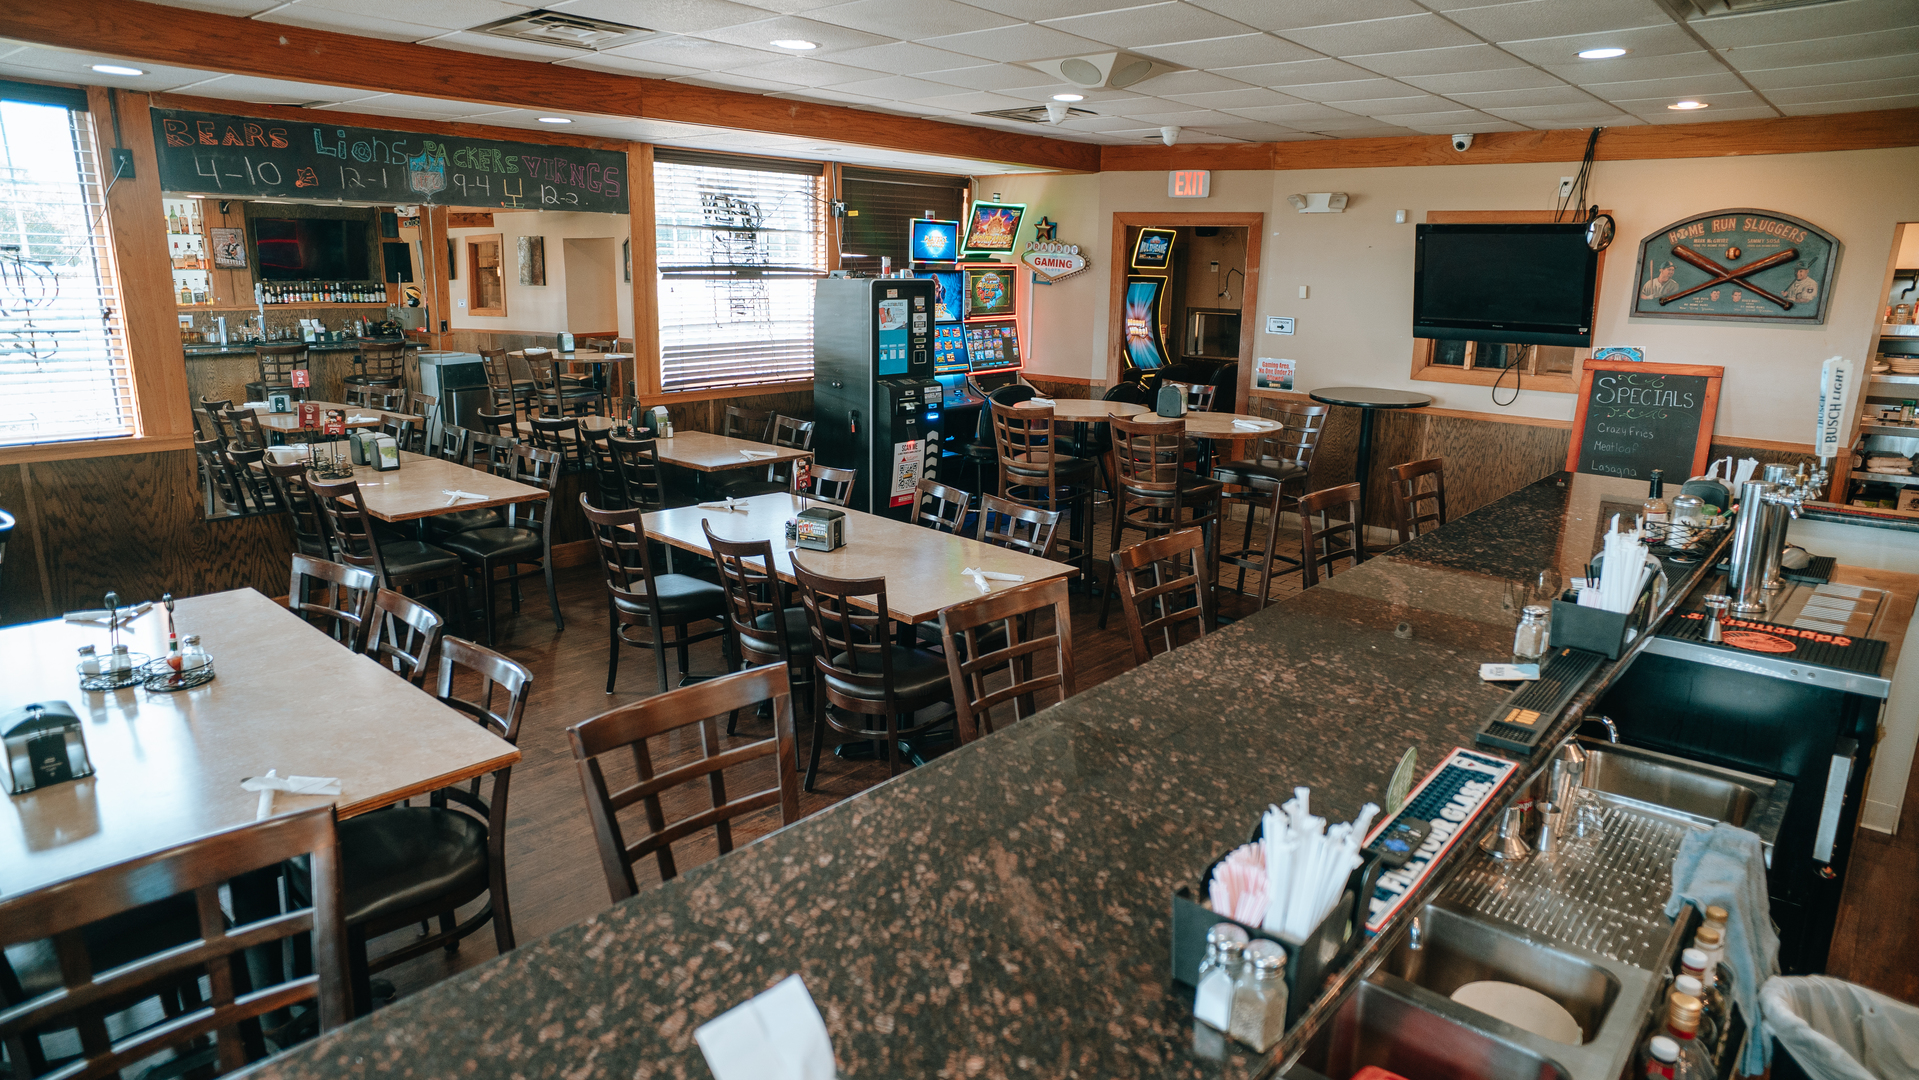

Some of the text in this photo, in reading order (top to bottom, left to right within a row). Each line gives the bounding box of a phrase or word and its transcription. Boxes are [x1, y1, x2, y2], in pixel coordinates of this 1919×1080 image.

[163, 119, 289, 149] BEARS
[313, 128, 408, 165] Lions
[423, 140, 520, 174] PACKERS
[195, 156, 282, 190] 4-10
[453, 173, 490, 197] 9-4
[541, 184, 579, 206] 12-2
[415, 175, 440, 189] NFL
[1174, 171, 1206, 196] EXIT
[1668, 218, 1808, 245] HOME RUN SLUGGERS
[1026, 242, 1078, 254] PRAIRIE
[1034, 257, 1073, 269] GAMING
[1262, 361, 1279, 369] Gaming
[1596, 377, 1694, 409] SPECIALS
[1825, 367, 1845, 443] BUSCH LIGHT
[1597, 422, 1654, 439] Crazy Fries
[901, 443, 912, 452] SCAN
[1594, 440, 1639, 454] Meatloaf
[1591, 459, 1638, 478] Lasagna
[1375, 861, 1427, 895] FILL
